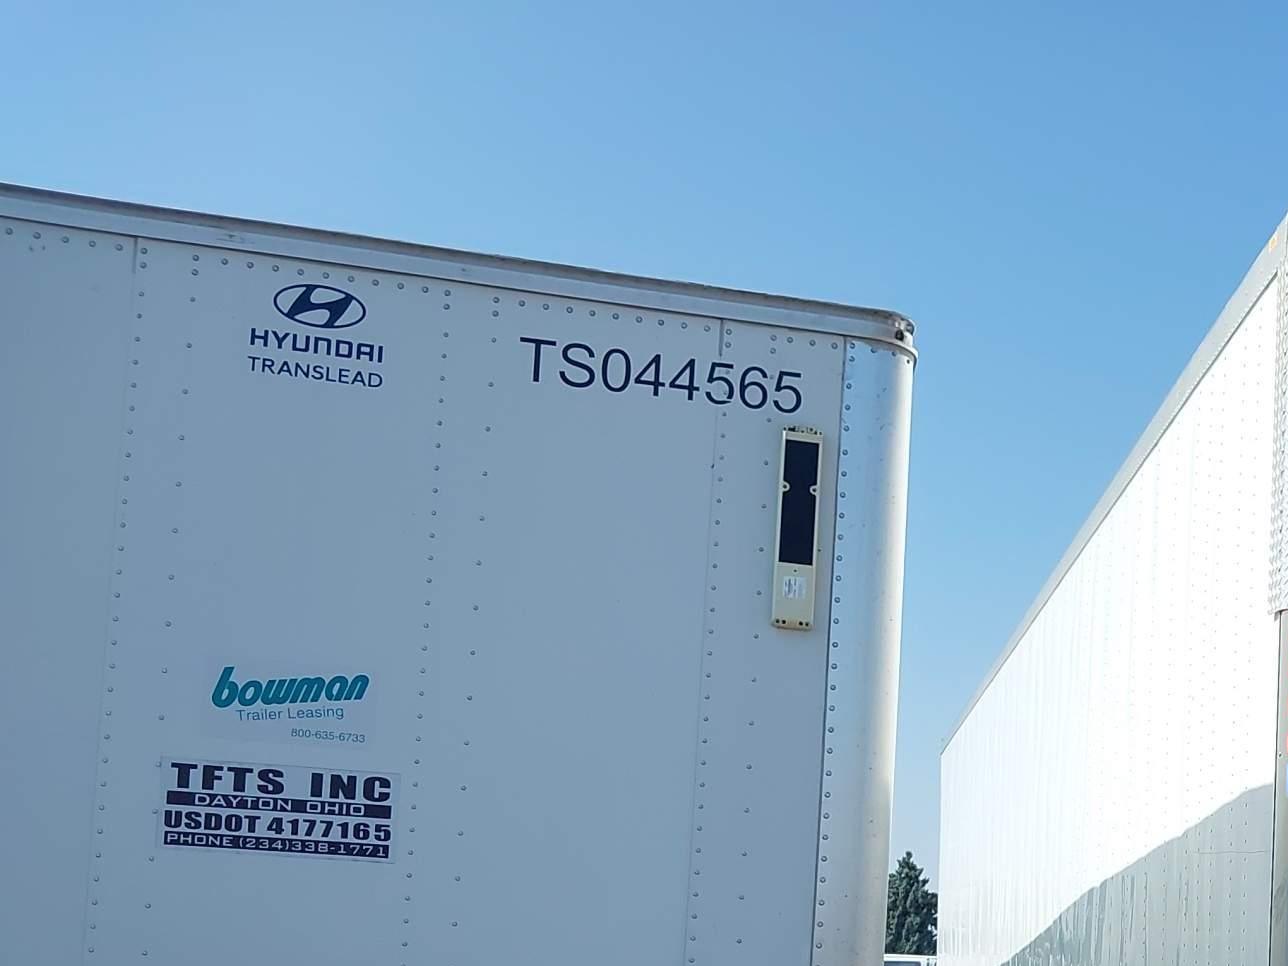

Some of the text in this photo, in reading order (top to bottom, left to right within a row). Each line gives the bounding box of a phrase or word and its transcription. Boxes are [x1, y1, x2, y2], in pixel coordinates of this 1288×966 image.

[250, 328, 384, 363] HYUNDAI
[248, 355, 383, 388] TRANSLEAD
[519, 336, 802, 414] TS044565
[211, 666, 370, 708] bowman
[236, 706, 345, 721] Trailer Leasing
[291, 728, 366, 743] 800-635-6733
[170, 762, 392, 802] TFTS INC
[194, 794, 365, 816] DAYTON OHIO
[164, 810, 392, 842] USDOT 4177165
[167, 833, 387, 857] PHONE (234)338-1771
